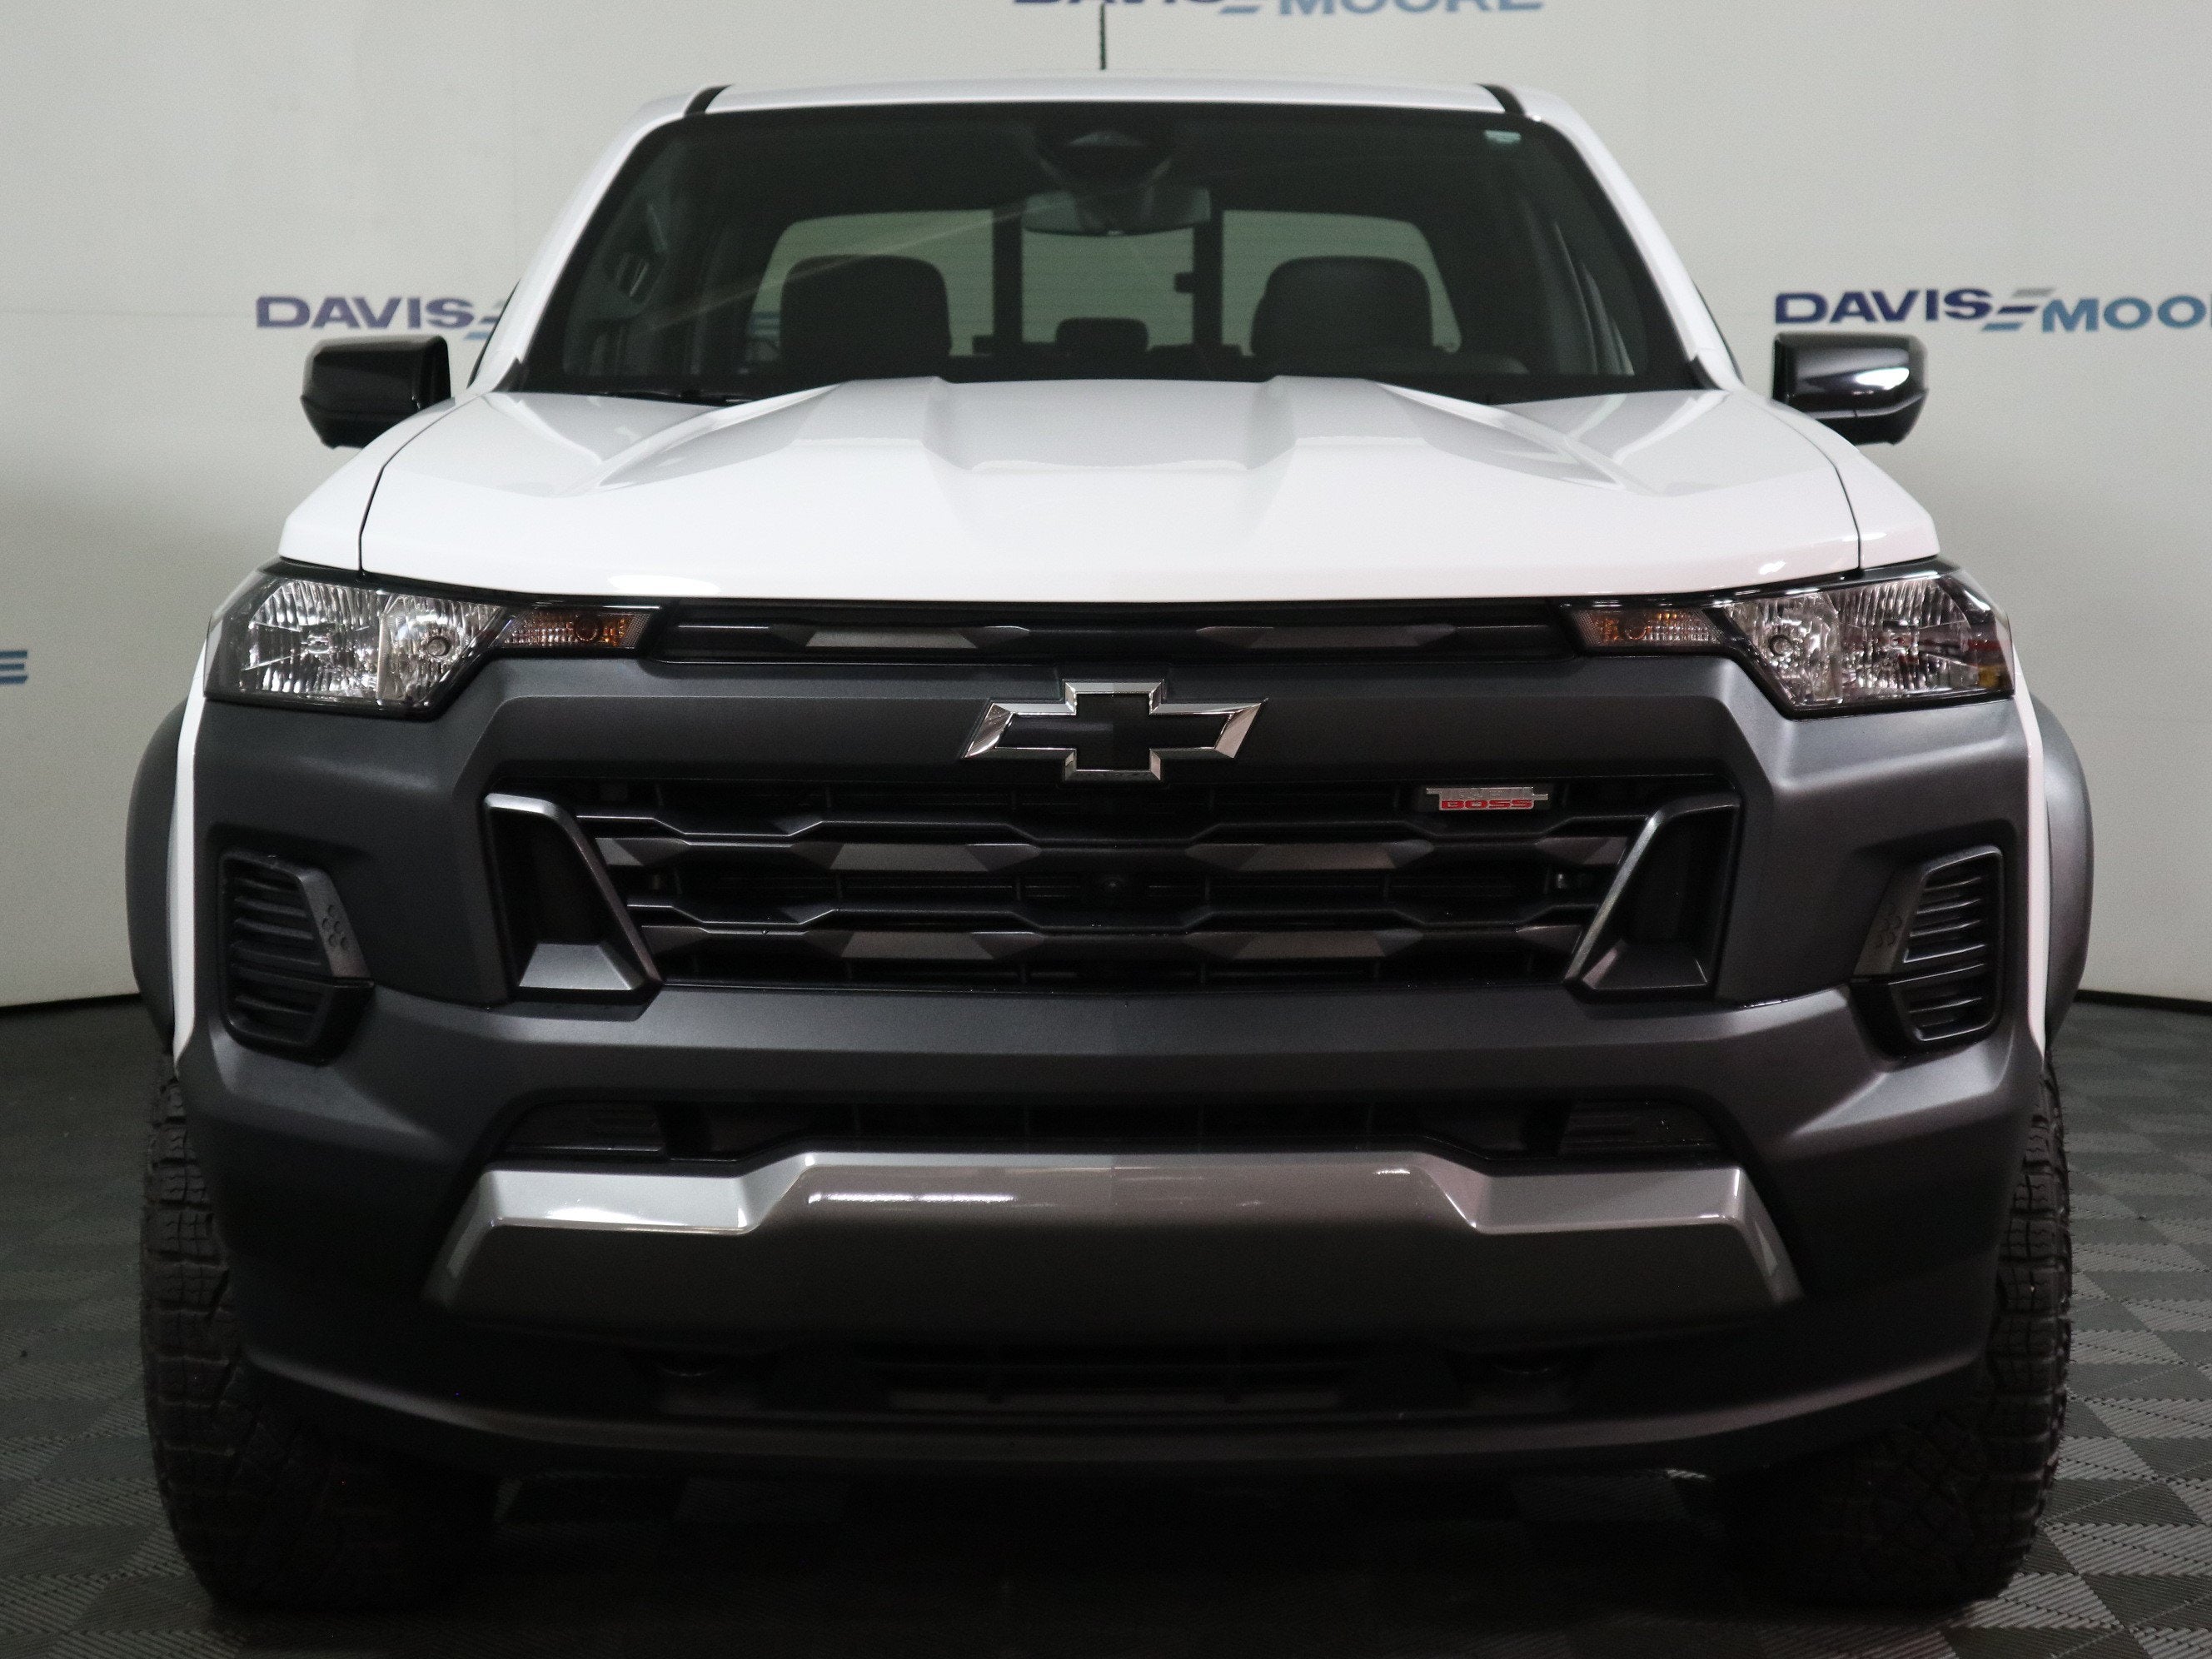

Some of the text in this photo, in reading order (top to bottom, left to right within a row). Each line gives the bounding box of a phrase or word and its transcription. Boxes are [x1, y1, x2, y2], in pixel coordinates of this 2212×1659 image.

[256, 296, 475, 329] DAVIS
[1775, 287, 2212, 333] DAVIS MOO
[1441, 800, 1533, 810] BOSS
